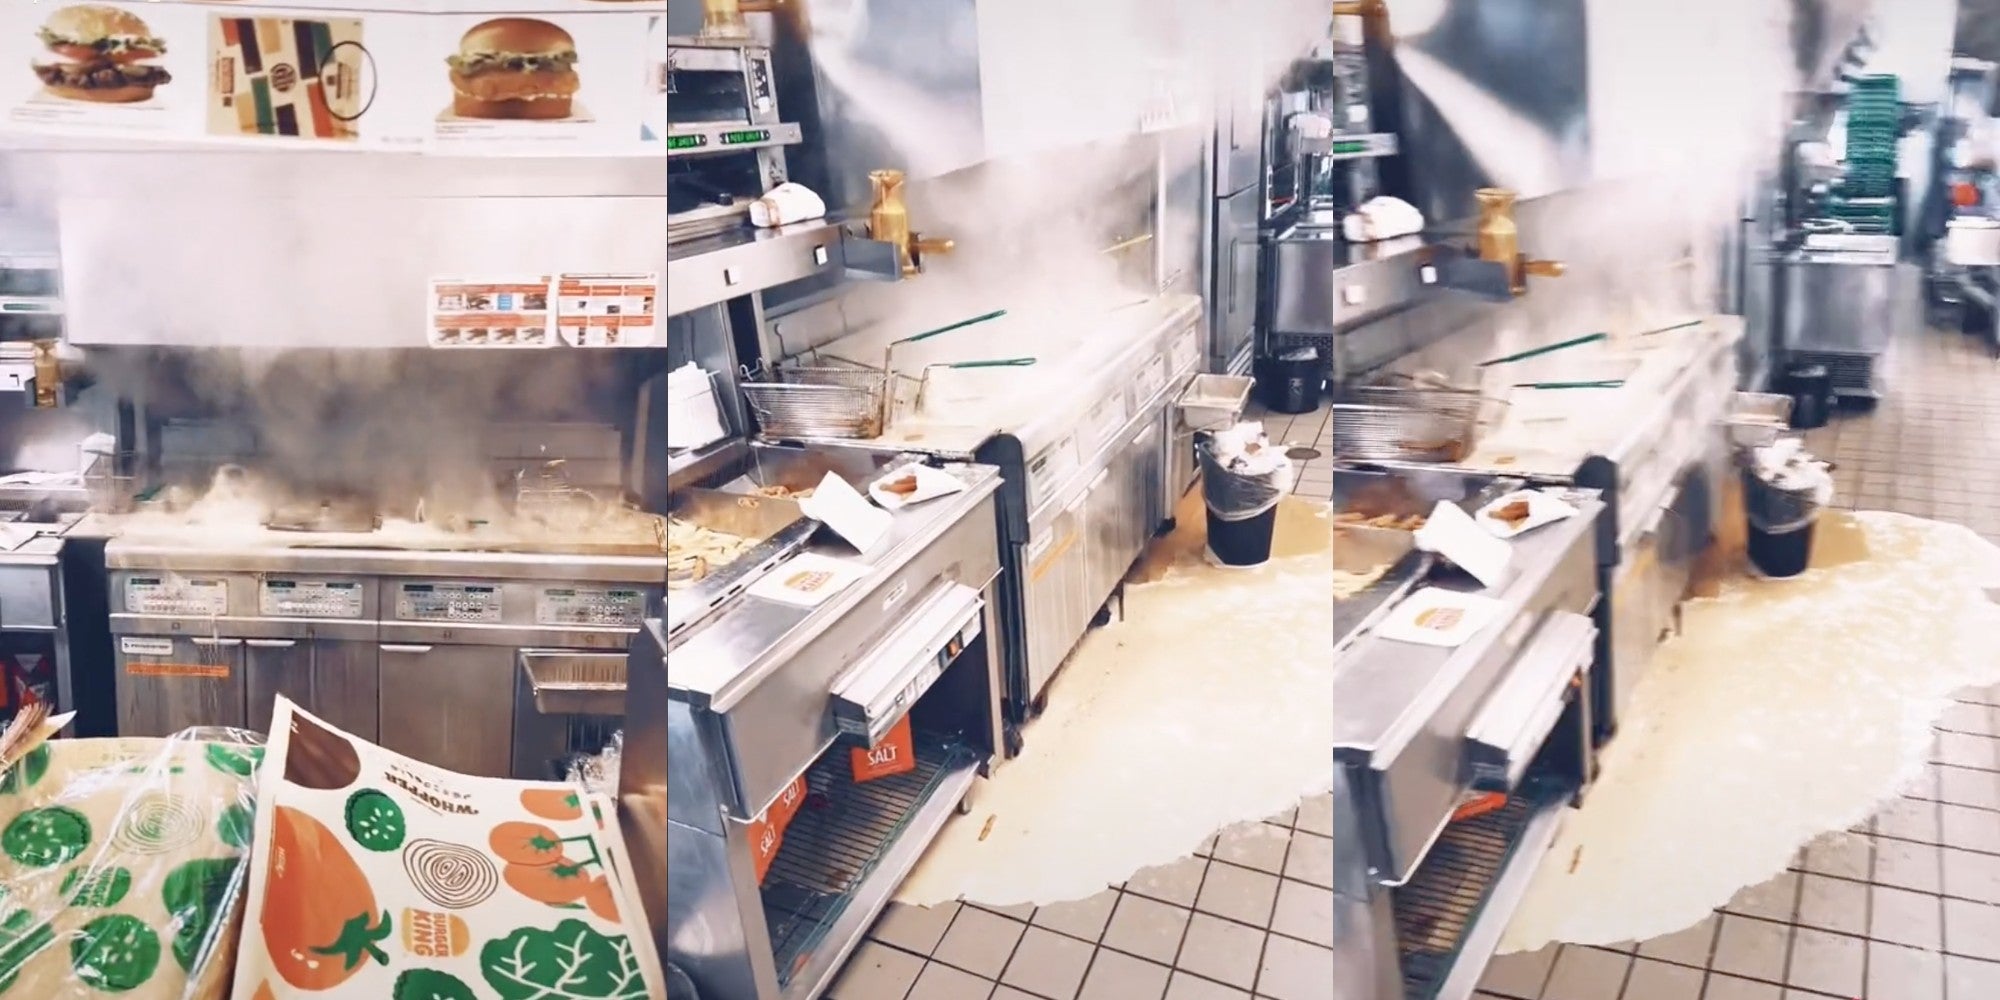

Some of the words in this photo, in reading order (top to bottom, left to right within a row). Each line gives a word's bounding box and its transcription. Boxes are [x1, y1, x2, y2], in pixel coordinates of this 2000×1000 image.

[867, 745, 897, 766] SALT
[384, 771, 479, 815] WHOPPER
[783, 780, 800, 809] SALT
[760, 824, 776, 858] SALT
[412, 908, 434, 957] KING
[433, 912, 449, 957] BURGER
